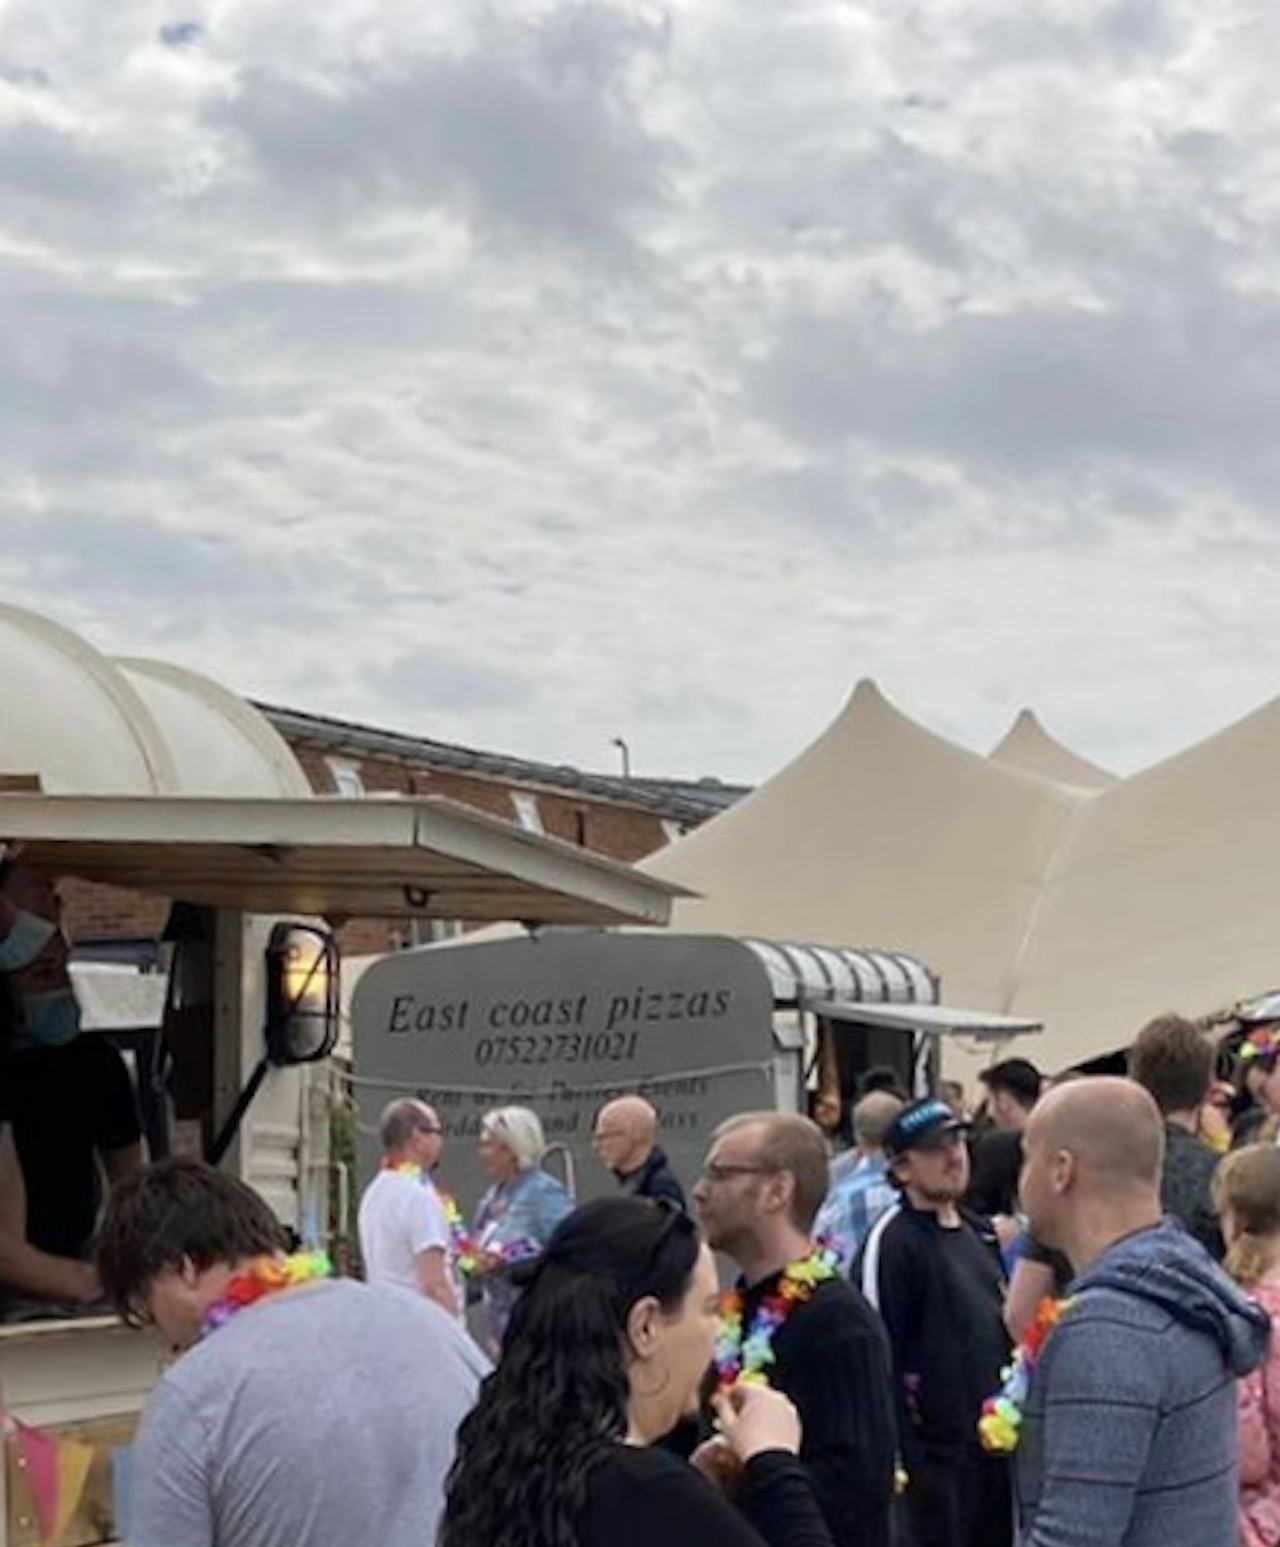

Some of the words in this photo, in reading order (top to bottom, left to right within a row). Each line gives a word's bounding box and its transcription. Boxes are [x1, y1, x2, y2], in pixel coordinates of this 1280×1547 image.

[388, 996, 469, 1033] East
[487, 994, 587, 1028] coast
[606, 986, 730, 1030] pizzas
[475, 1032, 638, 1067] 07522731021
